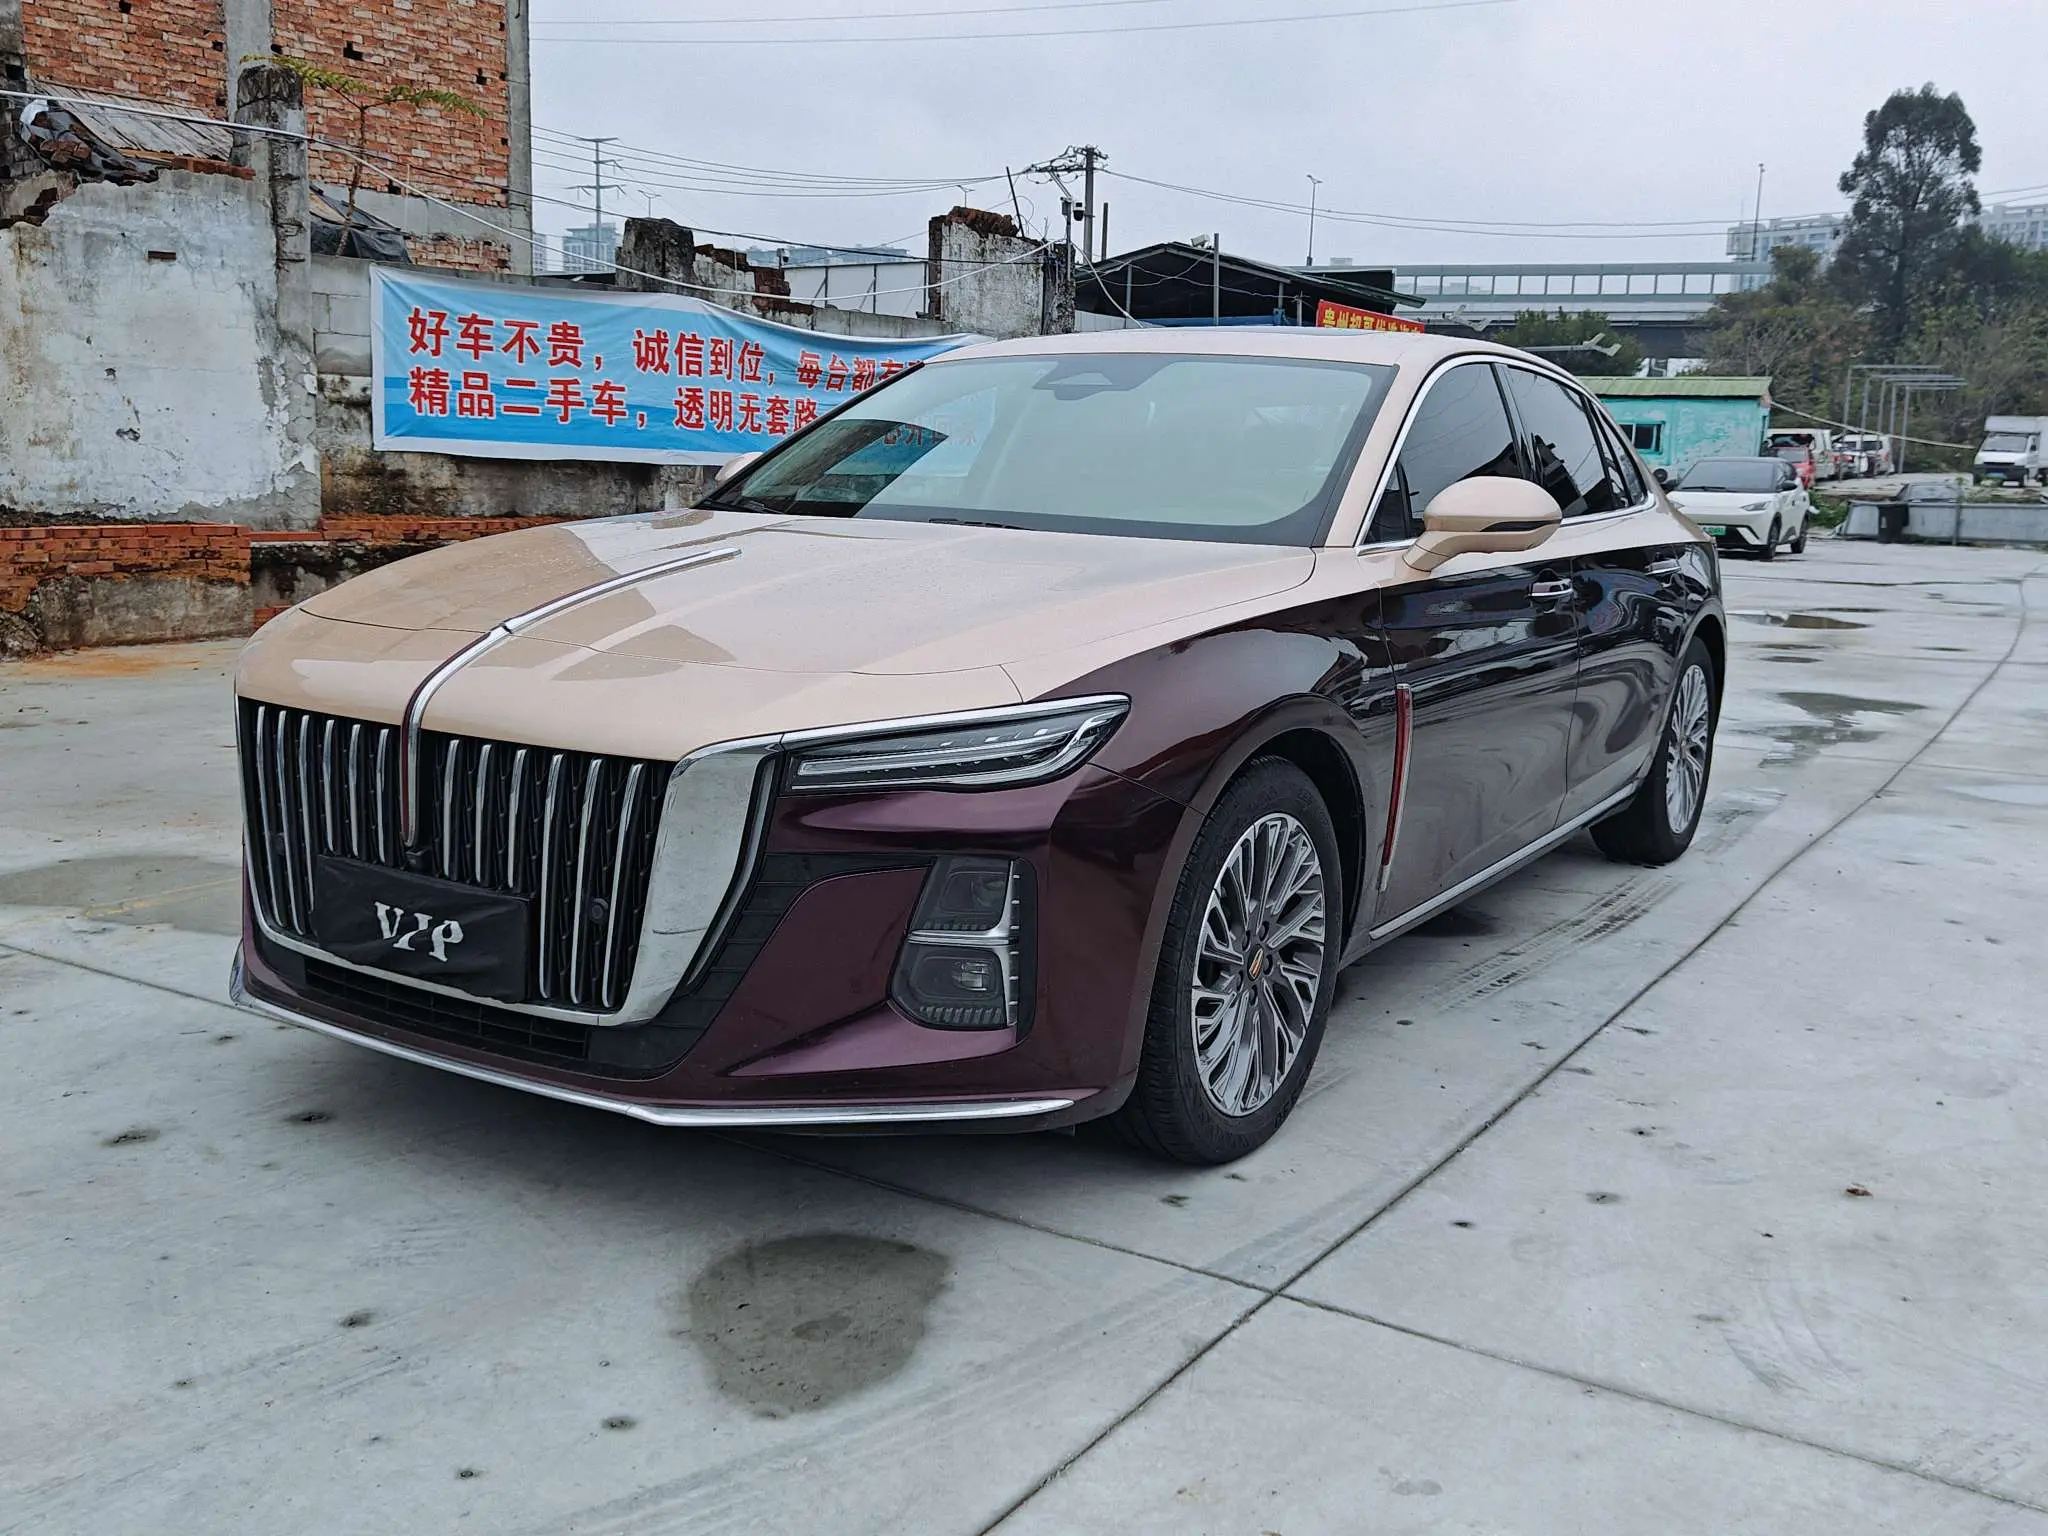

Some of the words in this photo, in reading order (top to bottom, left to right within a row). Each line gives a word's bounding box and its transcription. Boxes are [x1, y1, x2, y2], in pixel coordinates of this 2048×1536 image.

[408, 366, 819, 436] 精品二手车，透明无套路
[374, 901, 464, 963] VIP
